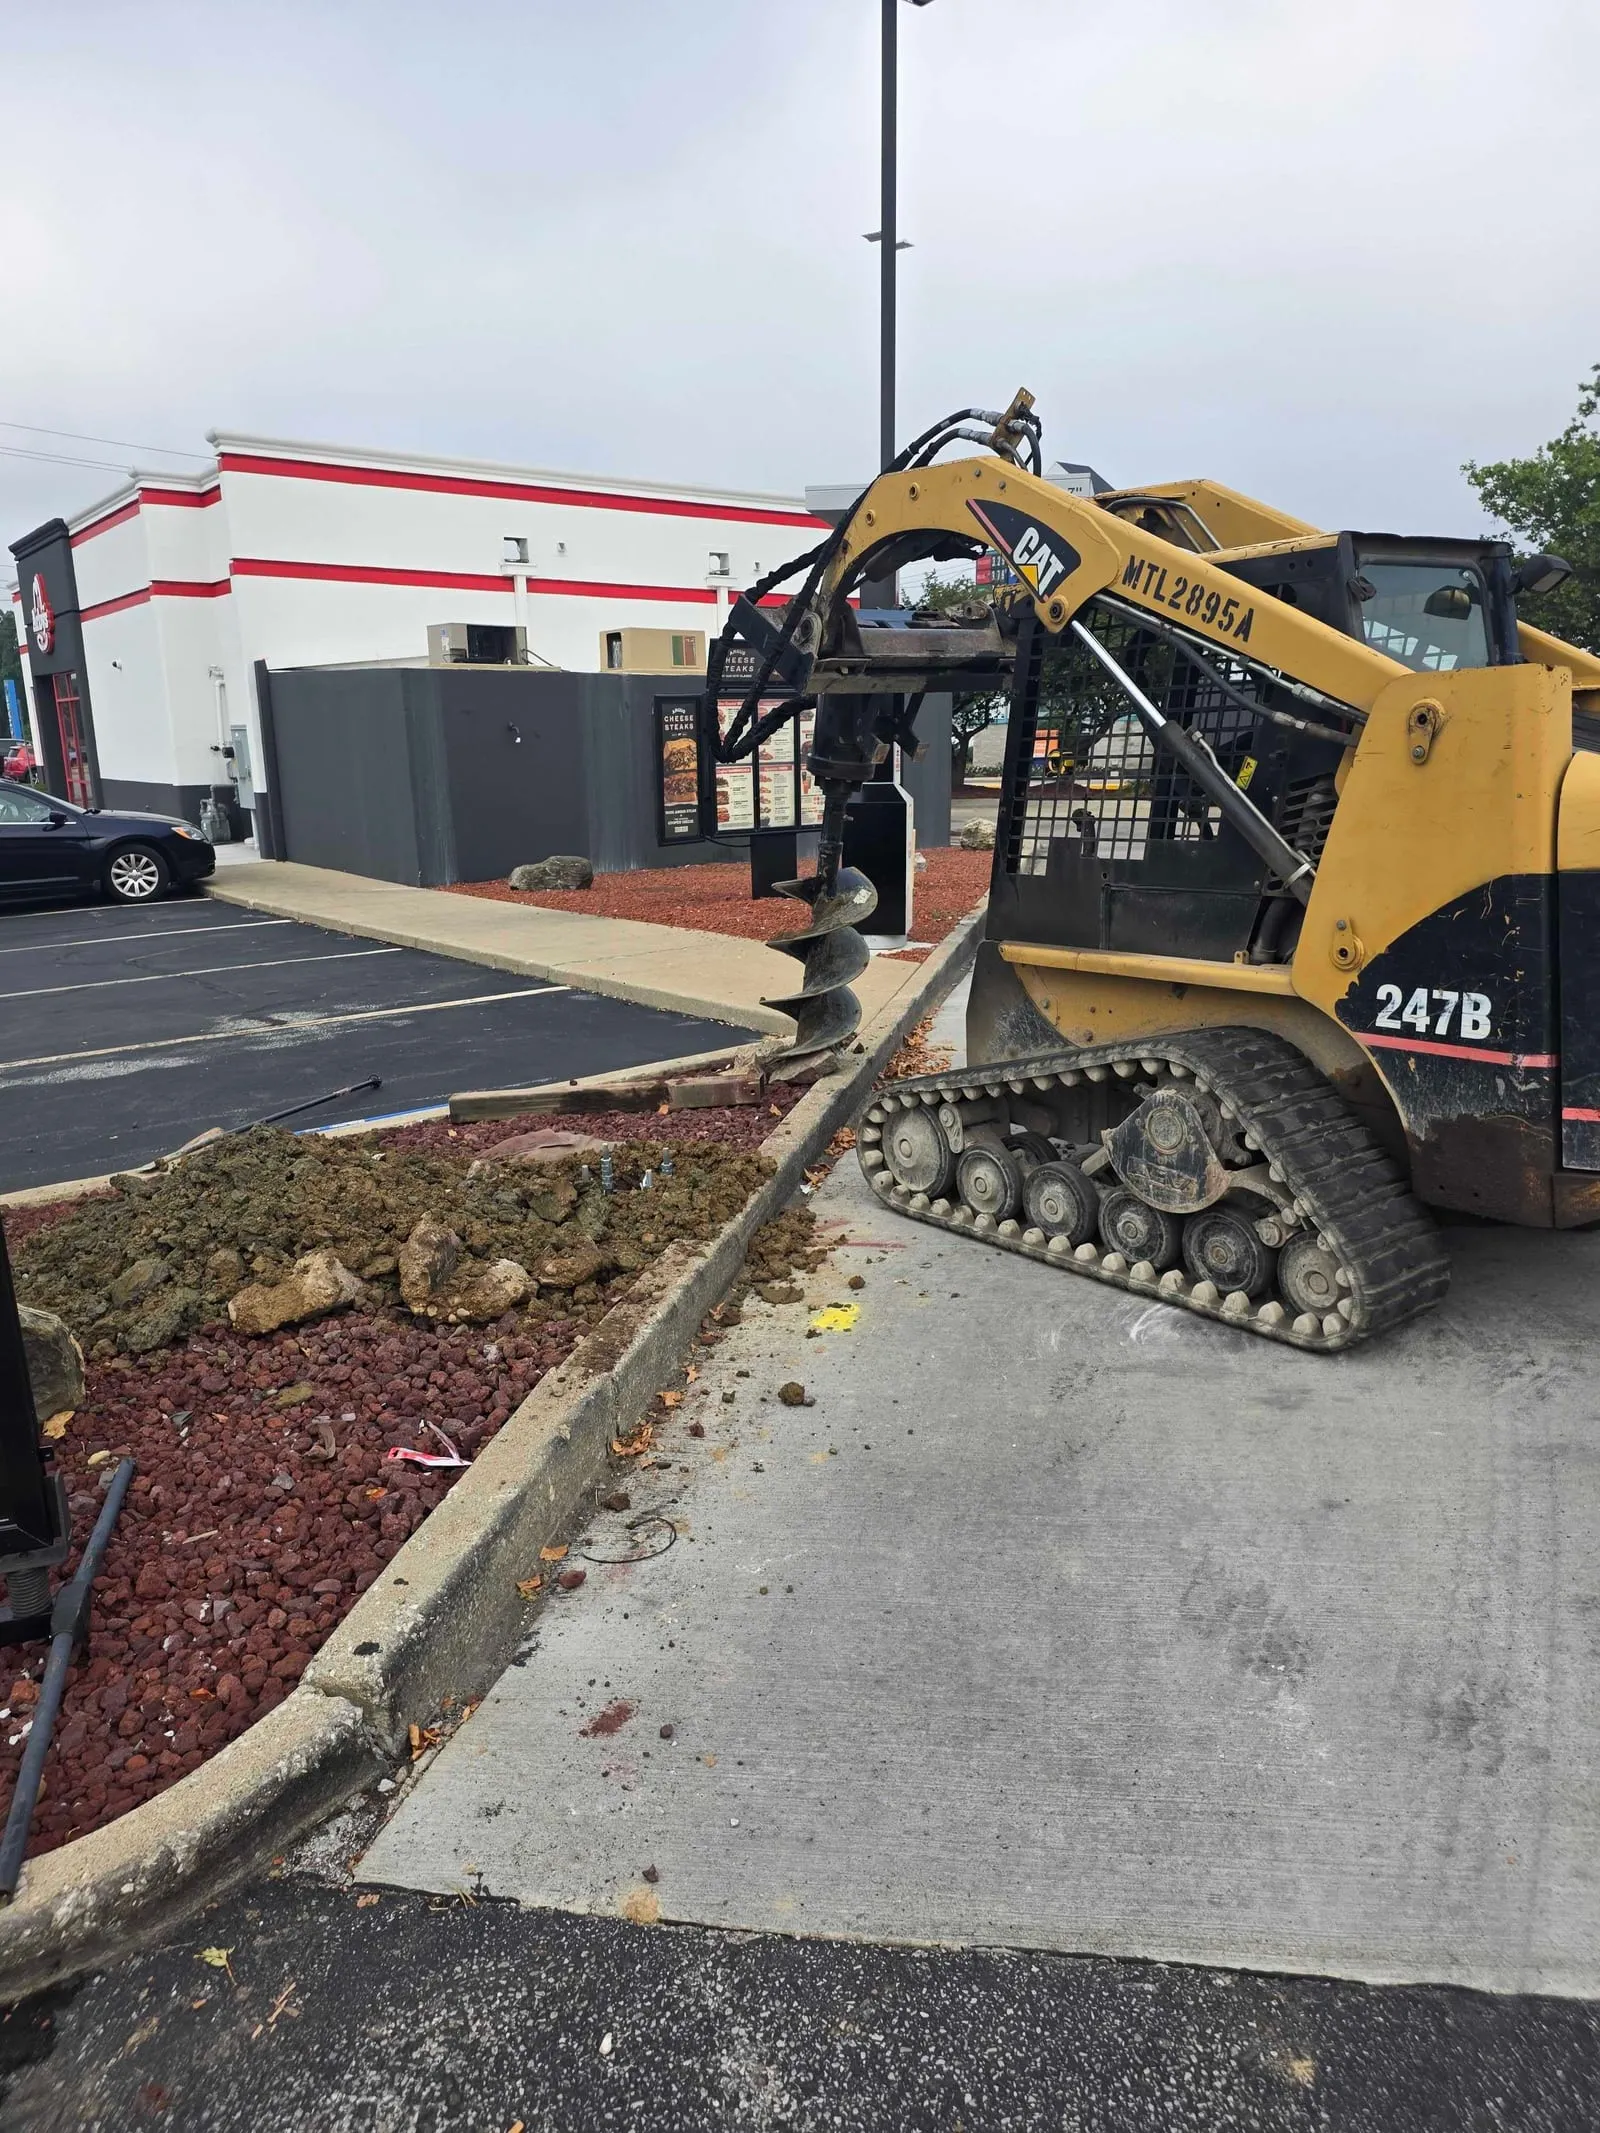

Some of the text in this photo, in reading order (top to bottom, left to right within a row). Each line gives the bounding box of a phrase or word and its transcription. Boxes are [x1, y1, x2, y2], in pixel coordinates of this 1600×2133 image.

[1012, 527, 1065, 596] CAT
[1121, 554, 1256, 642] MTL2895A
[725, 656, 756, 664] HEESE
[663, 714, 694, 722] CHEESE
[664, 722, 694, 731] STEAKS
[1375, 983, 1493, 1041] 247B
